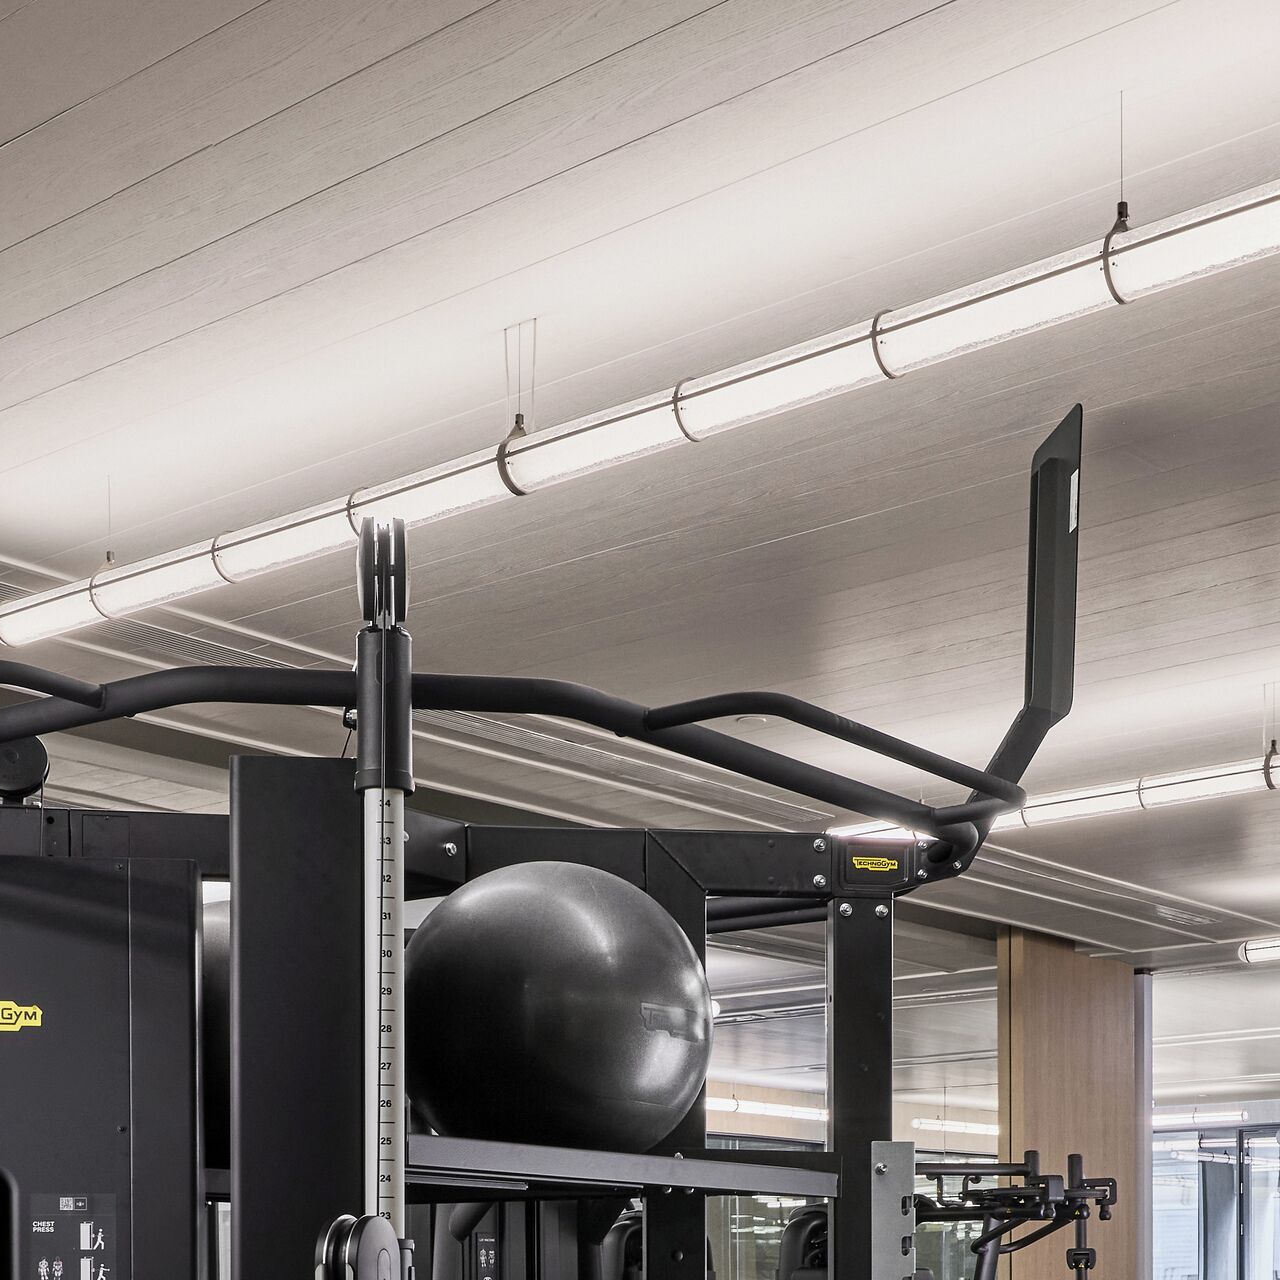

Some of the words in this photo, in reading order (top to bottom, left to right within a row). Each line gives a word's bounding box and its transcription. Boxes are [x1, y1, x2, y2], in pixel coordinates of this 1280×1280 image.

[853, 858, 897, 869] TECHNOGYM
[381, 987, 392, 995] 29
[380, 1025, 392, 1033] 28
[380, 1062, 391, 1070] 27
[380, 1100, 392, 1108] 26
[380, 1137, 392, 1145] 25
[380, 1174, 391, 1182] 24
